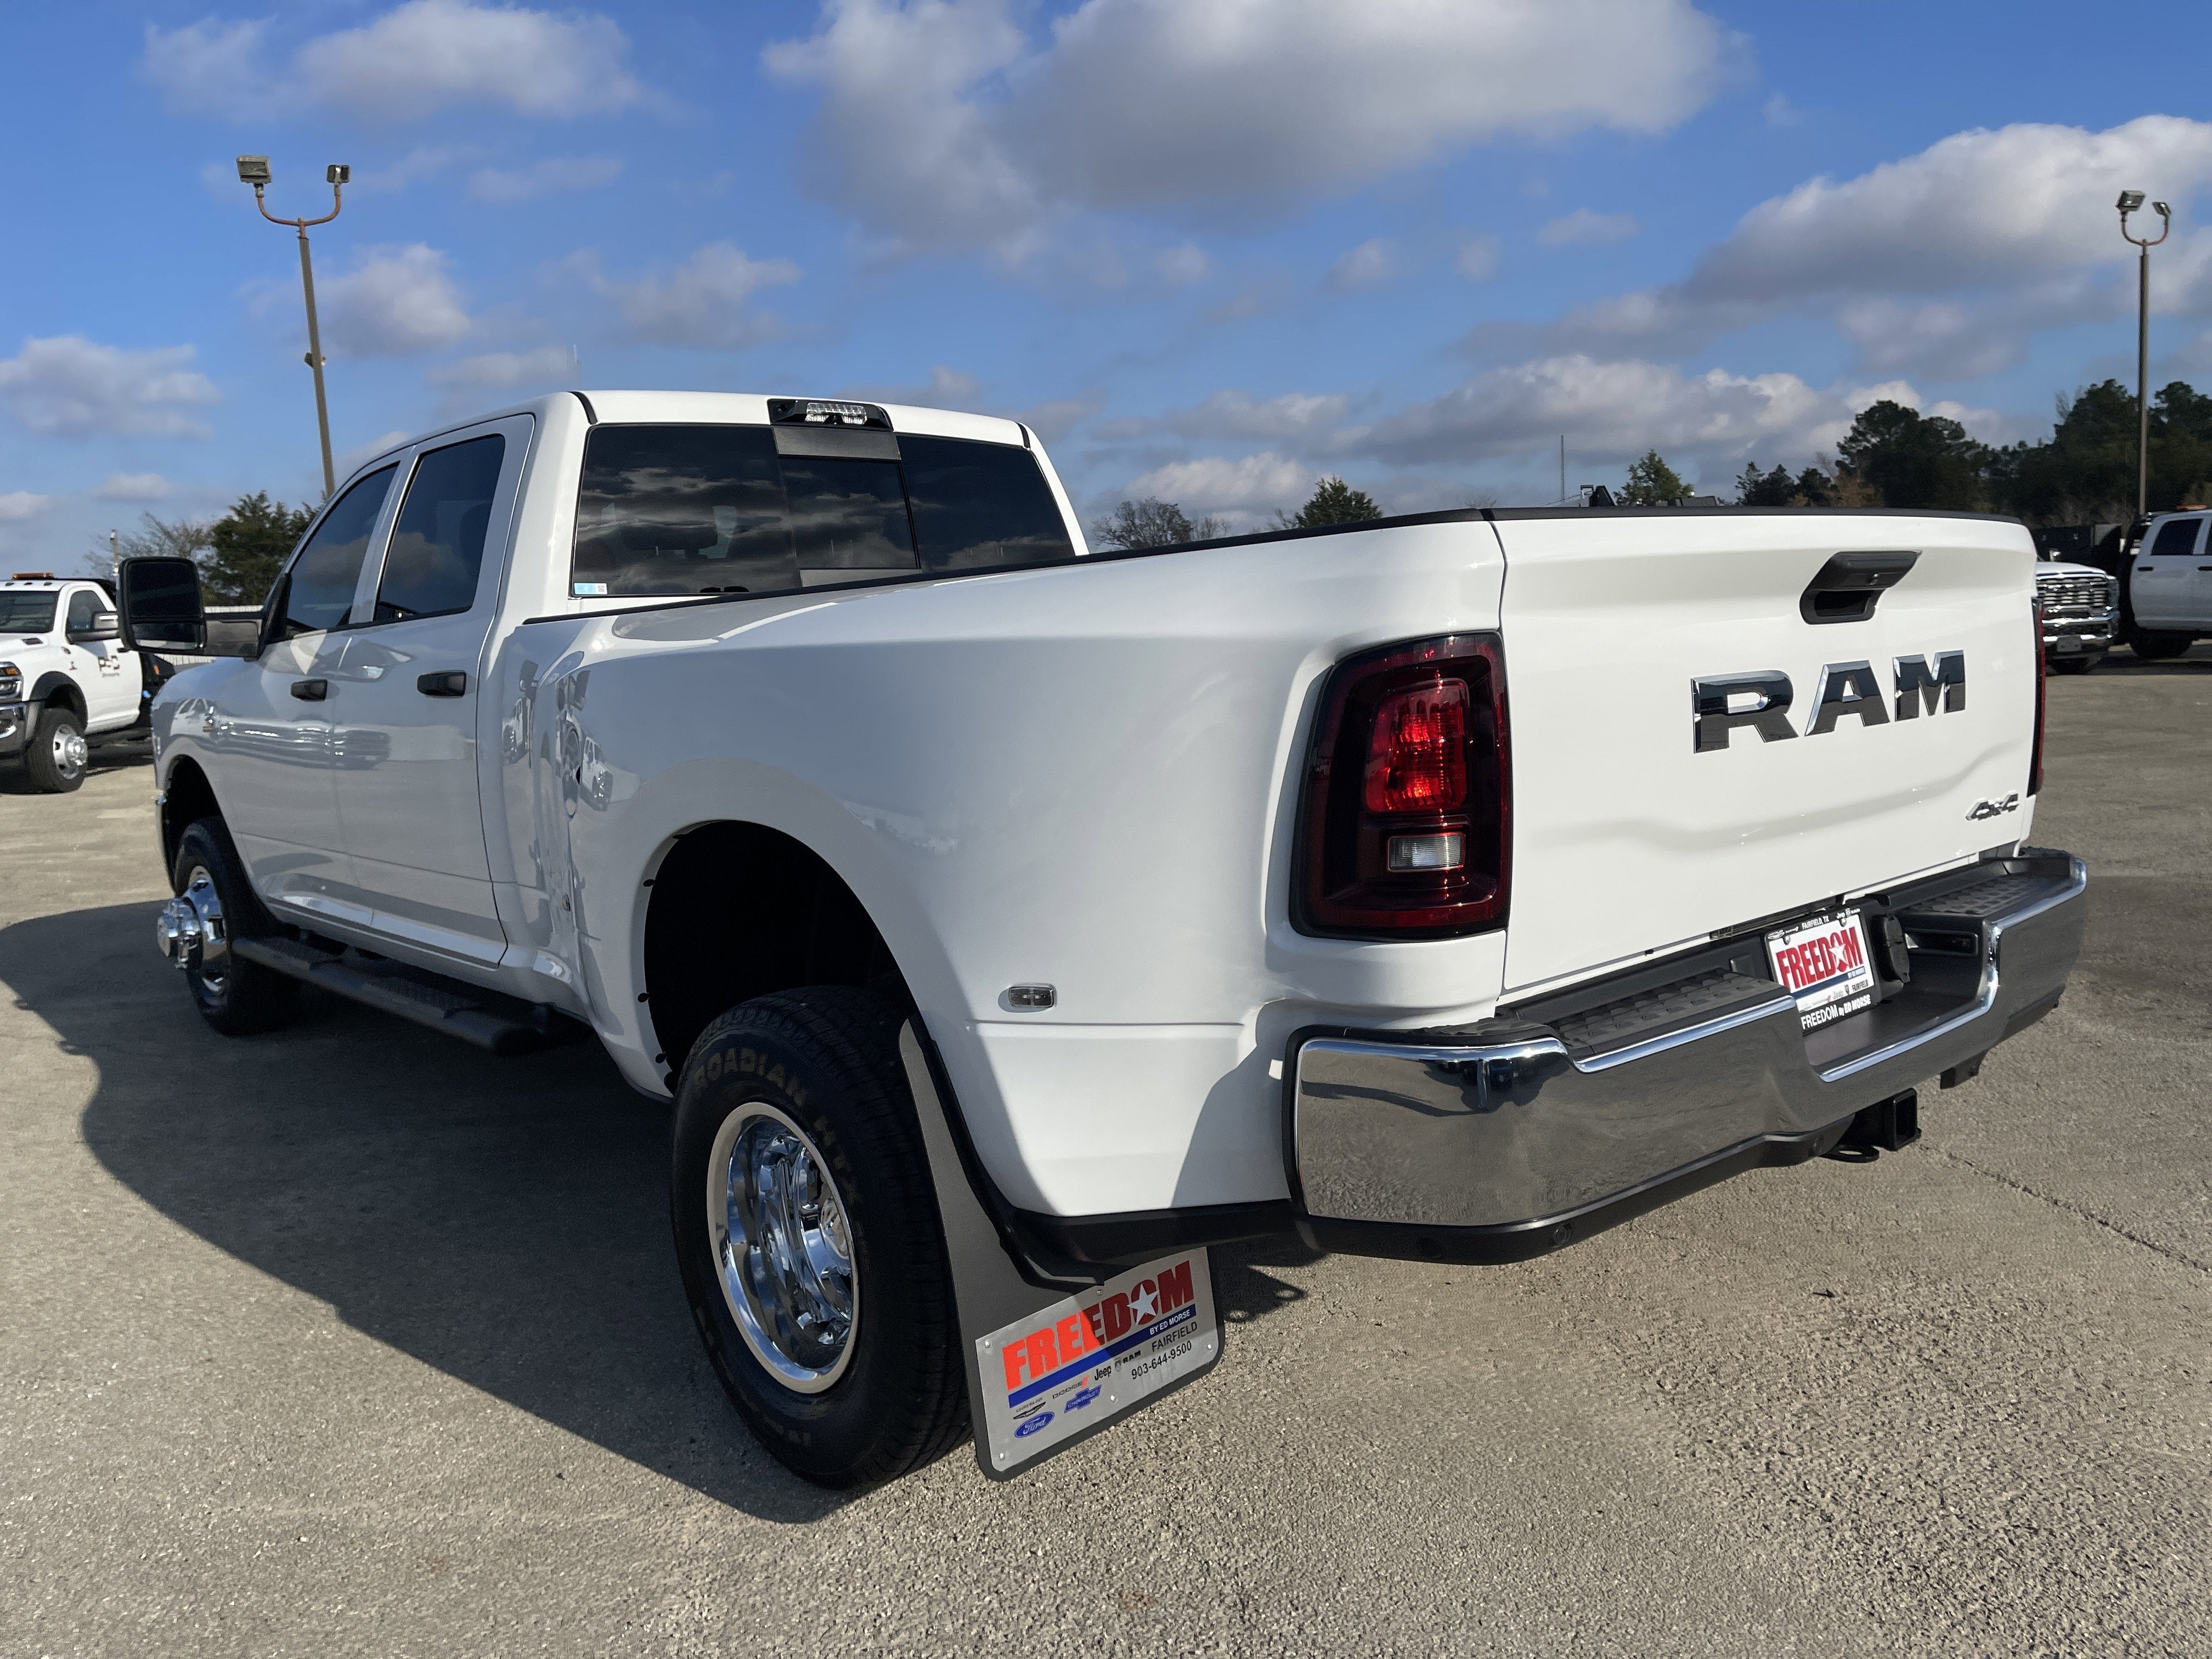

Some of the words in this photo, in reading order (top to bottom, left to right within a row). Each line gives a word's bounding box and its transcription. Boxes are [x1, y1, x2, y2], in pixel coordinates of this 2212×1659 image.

[1691, 650, 1966, 754] RAM
[1775, 927, 1864, 991] FREEDOM
[1801, 1004, 1838, 1030] FREEDOM
[1843, 1001, 1852, 1013] ED
[1851, 994, 1871, 1011] MORSE
[1002, 1260, 1194, 1391] FREEDOM
[1150, 1325, 1159, 1335] BY
[1159, 1321, 1168, 1330] ED
[1169, 1309, 1190, 1325] MORSE
[1152, 1322, 1197, 1352] FAIRFIELD
[1122, 1350, 1141, 1364] RAM
[1131, 1340, 1192, 1380] 903-644-9500
[1094, 1365, 1111, 1381] Jeep
[1052, 1381, 1083, 1399] DODGE
[1023, 1417, 1046, 1435] Ford
